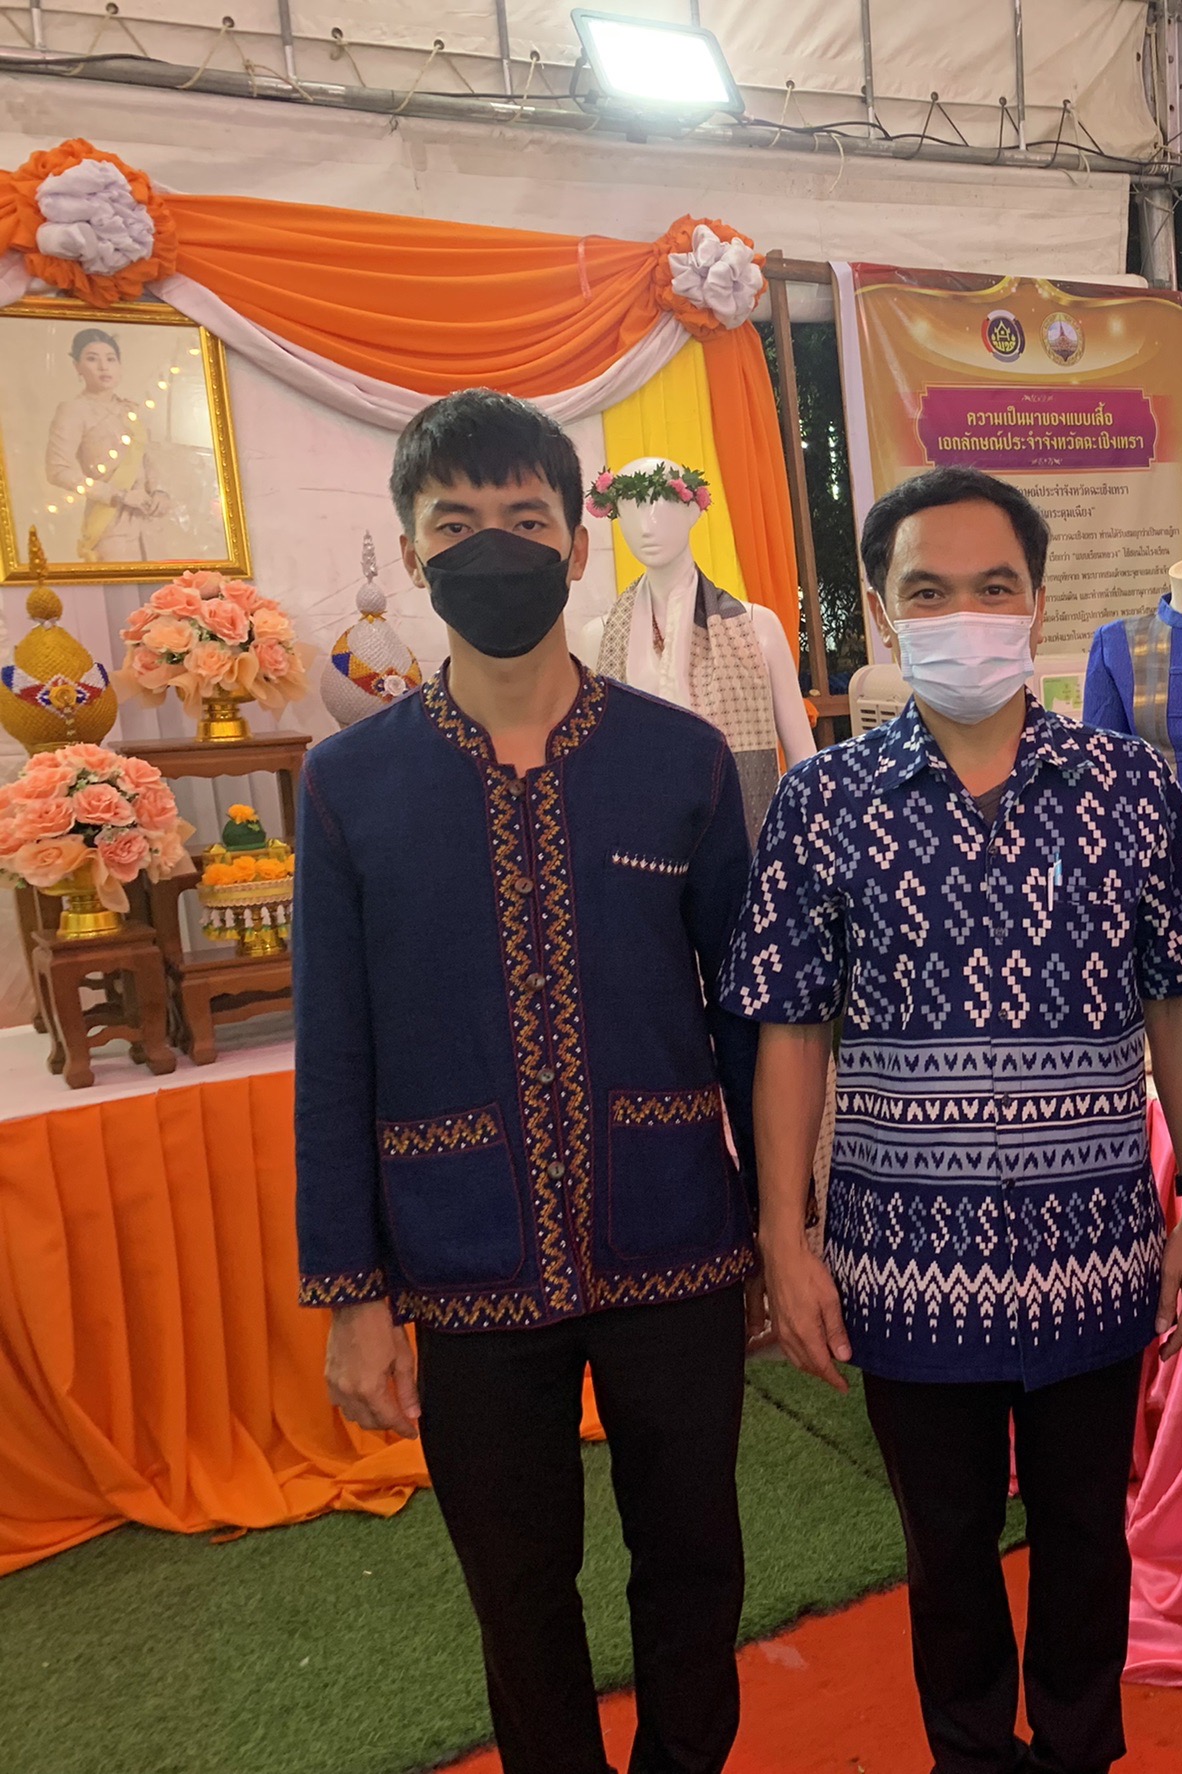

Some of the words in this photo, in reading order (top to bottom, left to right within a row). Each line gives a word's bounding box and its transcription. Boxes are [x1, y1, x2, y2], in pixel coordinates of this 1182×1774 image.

[967, 402, 1113, 426] ความเป็นมาของแบบเสื้อ
[938, 430, 1144, 451] เอกลักษณ์ประจำจังหวัดฉะเชิงเทรา
